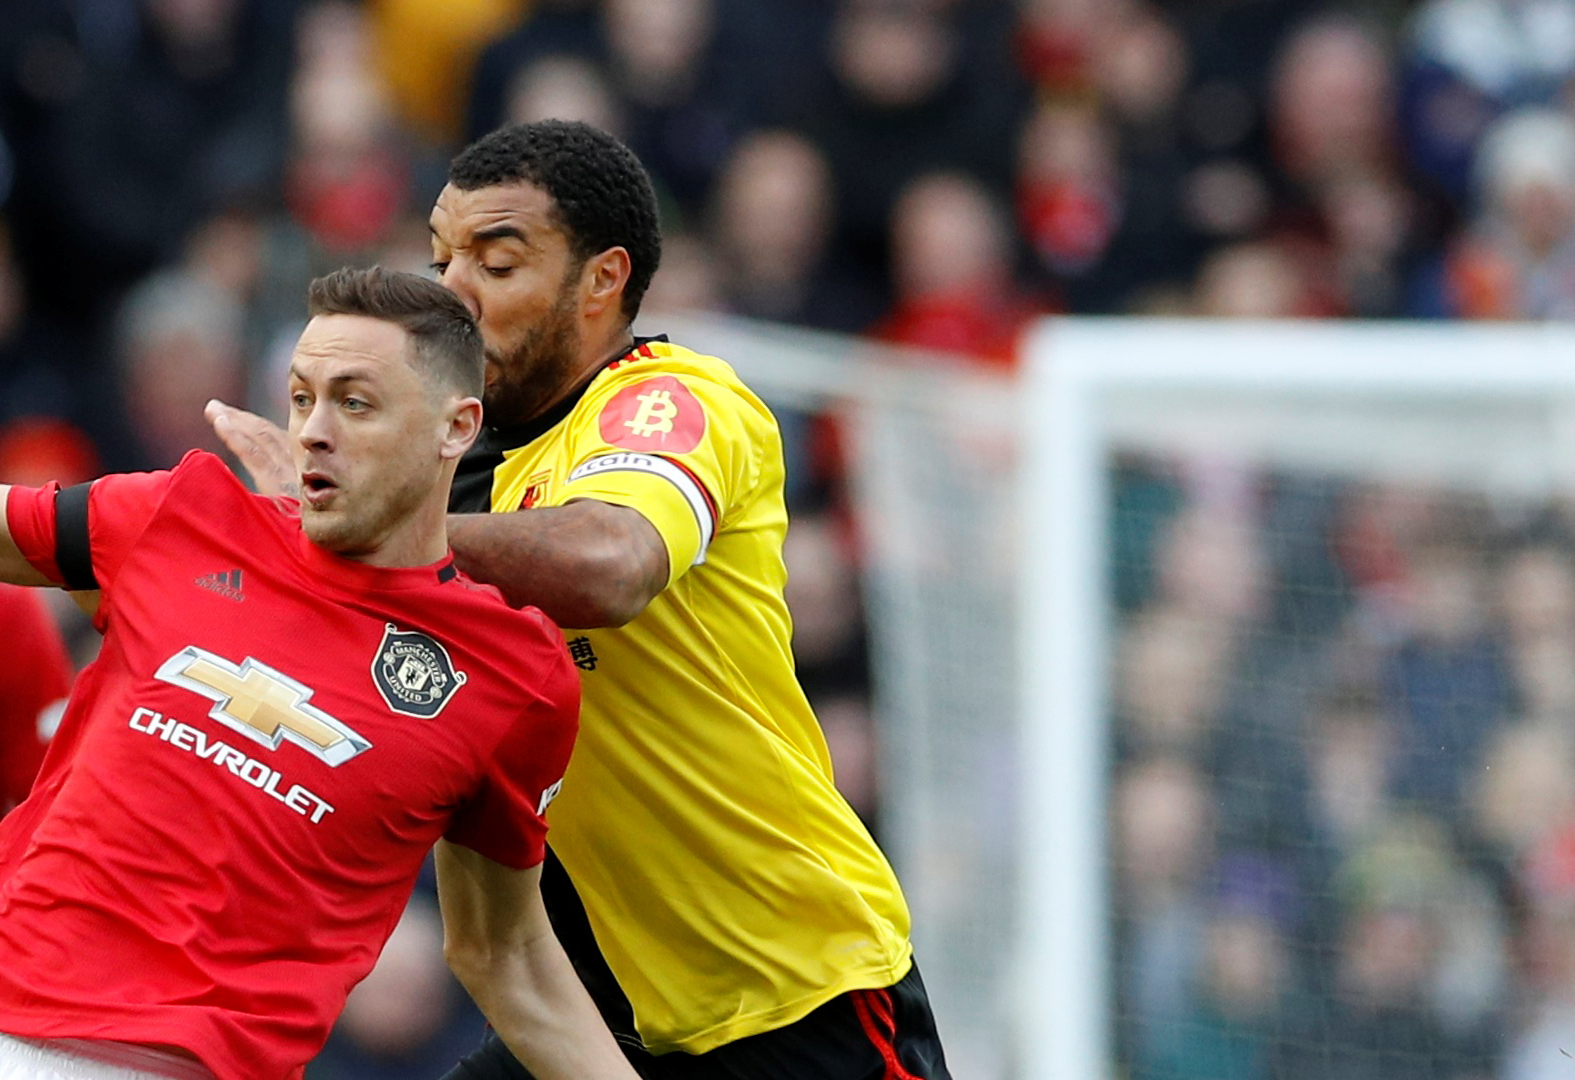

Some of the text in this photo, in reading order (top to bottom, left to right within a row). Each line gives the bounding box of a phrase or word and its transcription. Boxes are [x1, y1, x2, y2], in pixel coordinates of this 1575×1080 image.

[193, 577, 245, 602] adidas
[394, 645, 443, 685] MANCHESTER
[388, 675, 423, 701] UNITED
[128, 706, 335, 824] CHEVROLET
